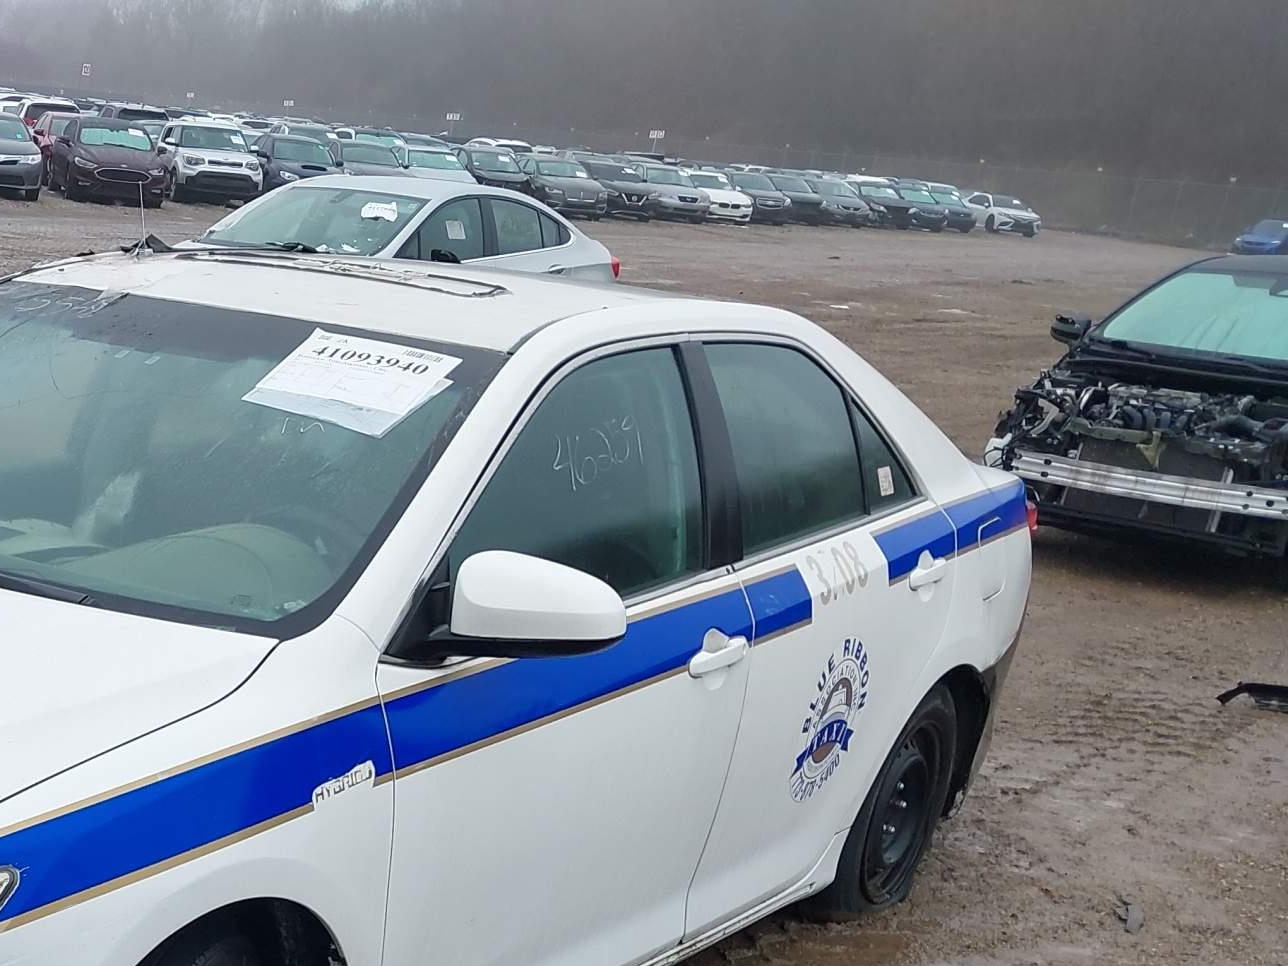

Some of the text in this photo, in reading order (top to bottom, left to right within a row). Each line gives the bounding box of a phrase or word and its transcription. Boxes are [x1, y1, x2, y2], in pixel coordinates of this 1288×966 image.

[312, 344, 429, 375] 41093940
[802, 638, 870, 733] BLUE RIBBON
[813, 722, 846, 751] TAXI
